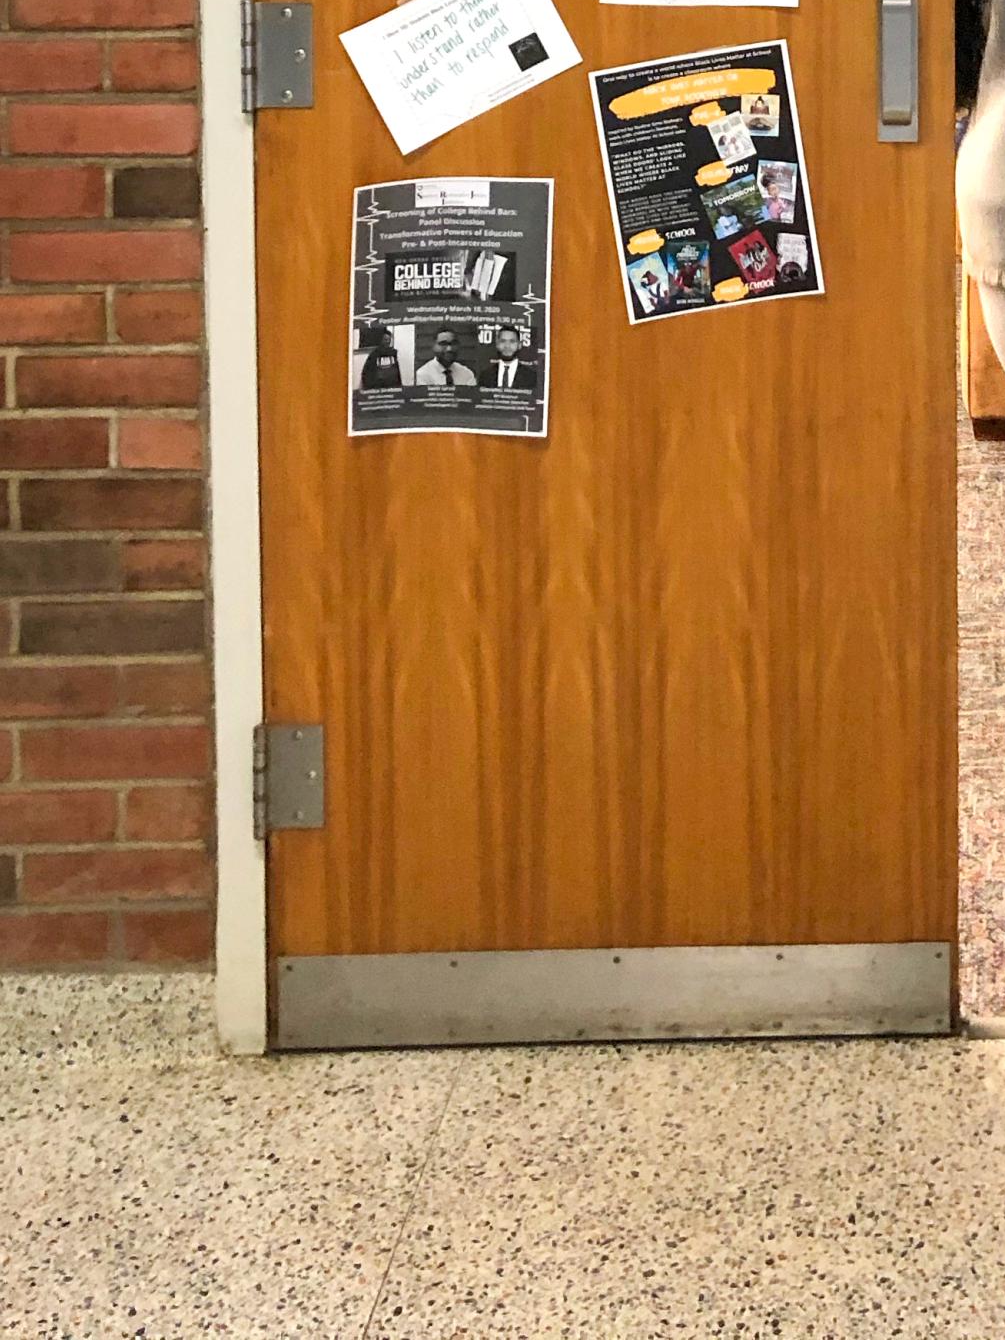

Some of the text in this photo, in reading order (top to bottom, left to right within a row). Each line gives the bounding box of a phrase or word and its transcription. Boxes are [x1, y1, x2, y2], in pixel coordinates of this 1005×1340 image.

[408, 22, 443, 54] listen
[444, 12, 458, 26] to
[399, 33, 464, 90] understand
[468, 1, 501, 32] rather
[448, 61, 464, 77] to
[465, 19, 510, 64] respond
[713, 185, 756, 206] TOMORROW
[387, 210, 426, 219] Screening
[438, 207, 466, 216] College
[468, 207, 496, 215] Behind
[419, 218, 485, 226] Panel Discussion
[380, 229, 442, 239] Transformative
[444, 228, 472, 236] Powers
[484, 229, 523, 237] Education
[665, 228, 695, 240] SCHOOL
[394, 262, 461, 279] COLLEGE
[394, 278, 461, 291] BEHIND BARS
